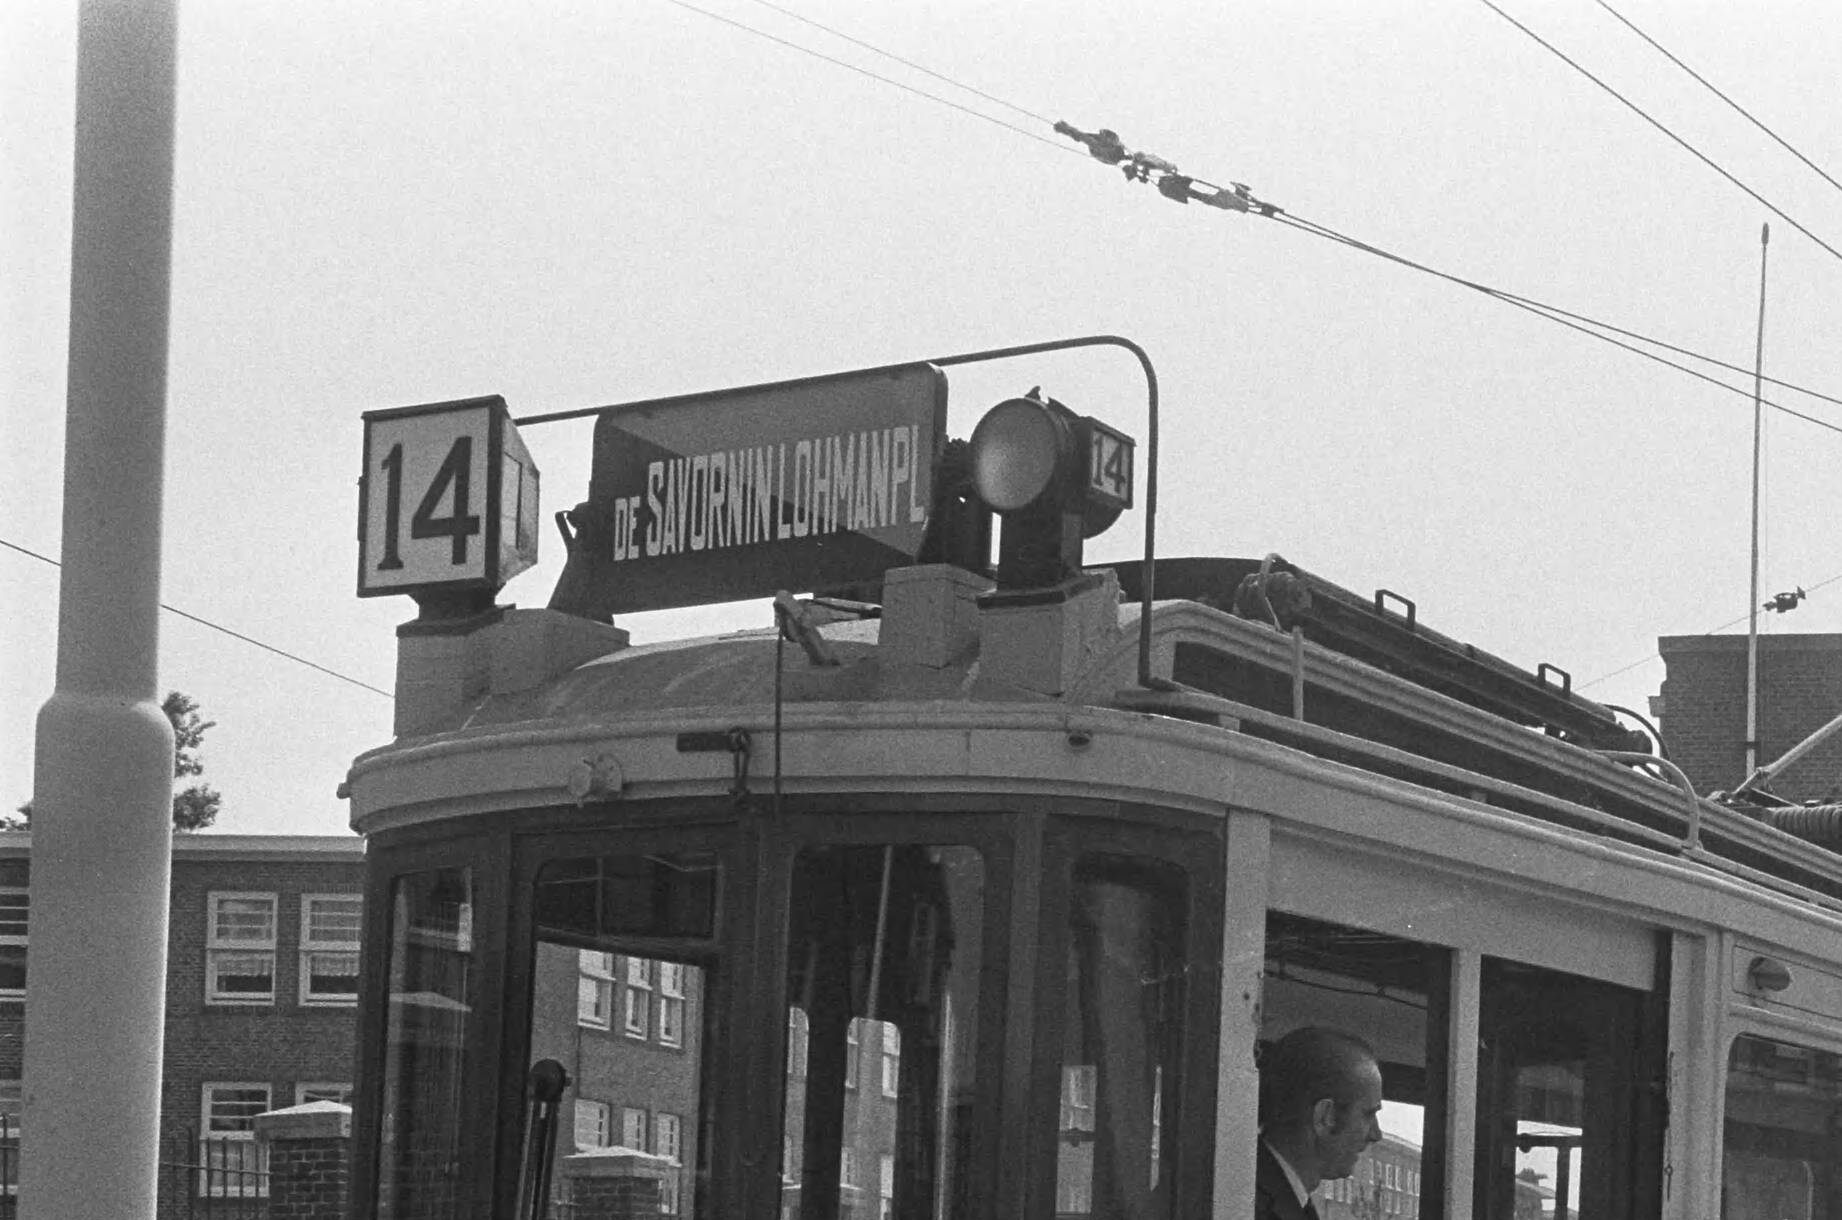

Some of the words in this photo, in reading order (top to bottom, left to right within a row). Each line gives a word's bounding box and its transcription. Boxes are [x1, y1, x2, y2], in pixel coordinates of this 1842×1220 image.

[377, 436, 481, 571] 14
[613, 496, 640, 561] DE
[646, 447, 774, 556] SAVORNIN
[778, 425, 925, 541] LOHMANPL
[1092, 434, 1127, 494] 14
